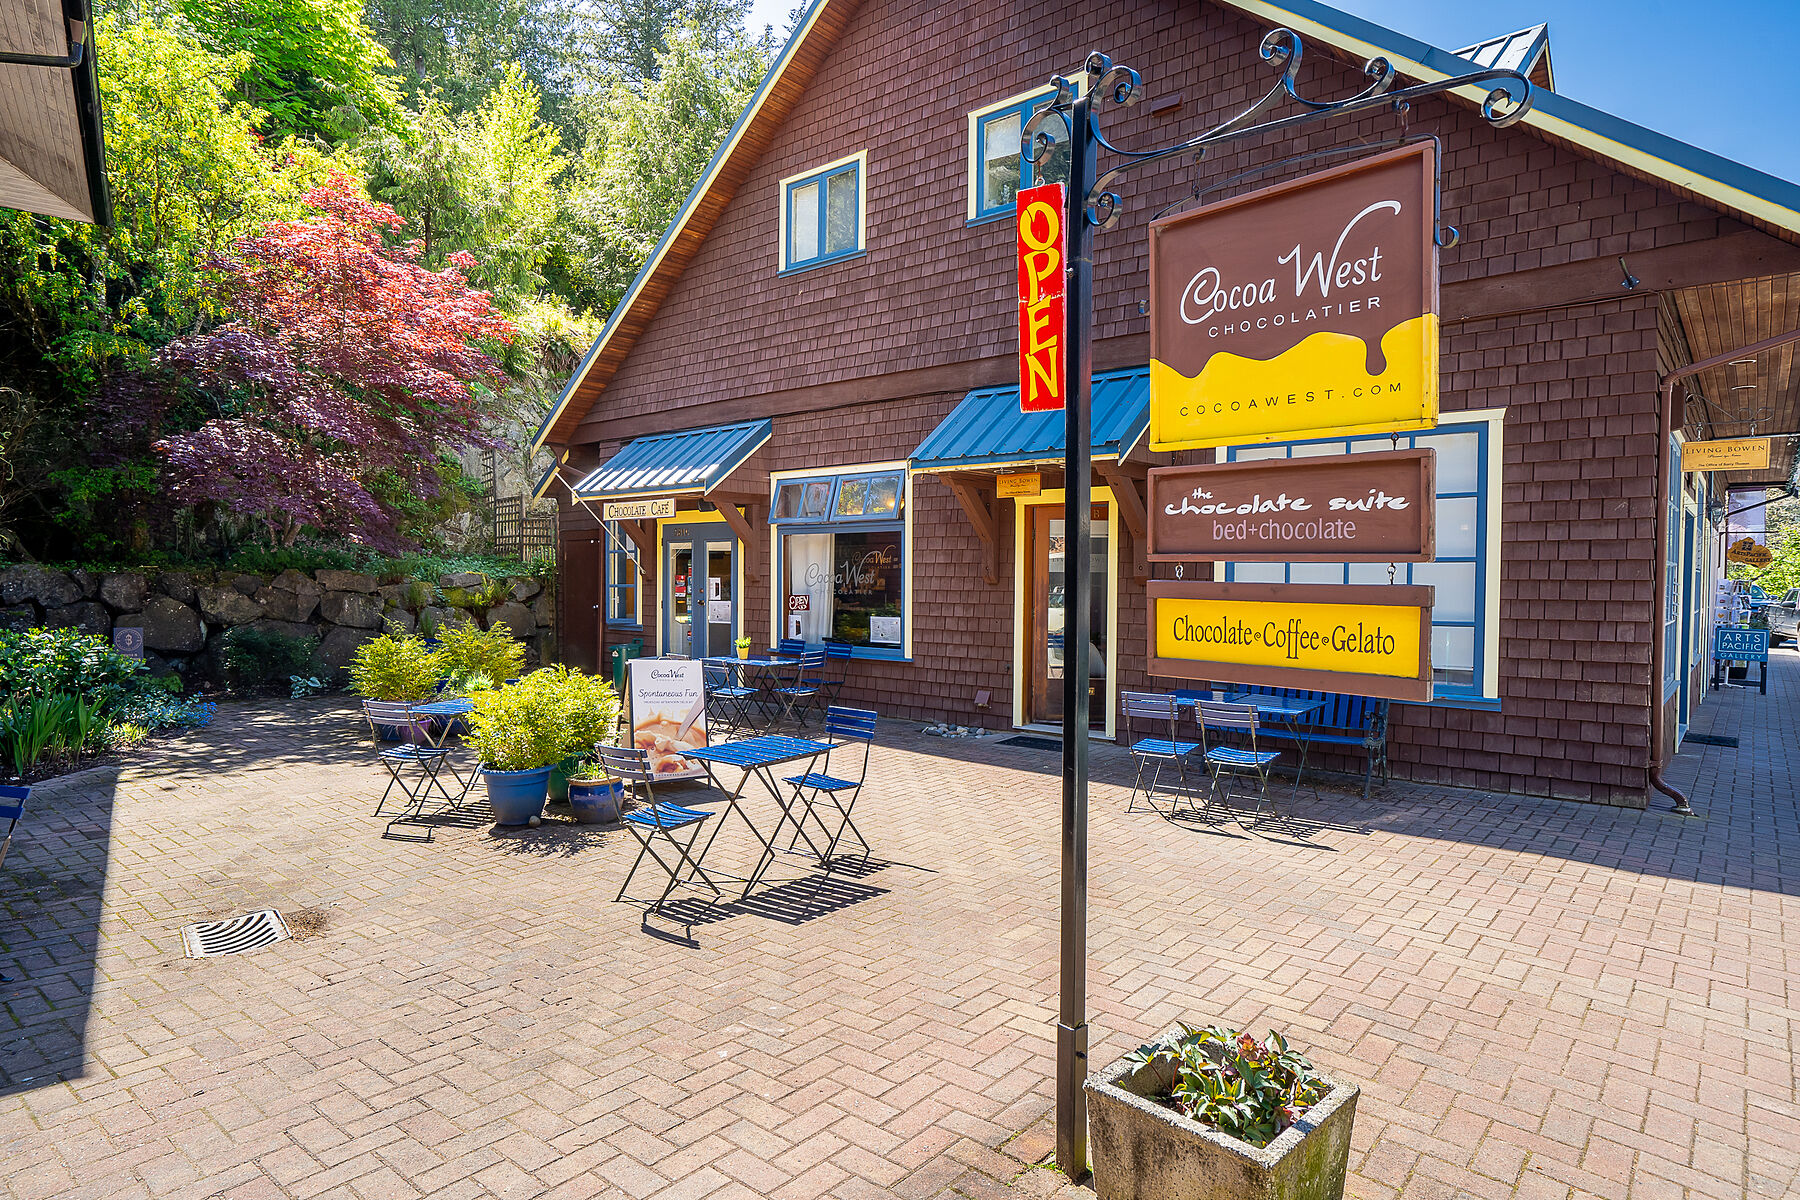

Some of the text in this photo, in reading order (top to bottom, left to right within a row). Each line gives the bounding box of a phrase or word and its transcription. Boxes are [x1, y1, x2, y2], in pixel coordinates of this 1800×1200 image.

[1179, 200, 1401, 325] Cocoa West
[1019, 201, 1060, 402] OPEN
[1208, 296, 1381, 338] CHOCOLATIER
[1179, 382, 1402, 417] COCOAWEST.COM
[1164, 489, 1410, 516] chocolate suite
[1192, 486, 1213, 500] the
[608, 505, 647, 519] CHOCOLATE
[1212, 518, 1356, 541] bed+chocolate
[805, 550, 881, 587] Cocoa West
[788, 595, 808, 609] OPEN
[1173, 615, 1395, 660] Chocolate Coffee Gelato
[1722, 642, 1761, 650] PACIFIC
[1723, 633, 1761, 643] ARTS
[638, 688, 698, 699] Spontaneous Fun
